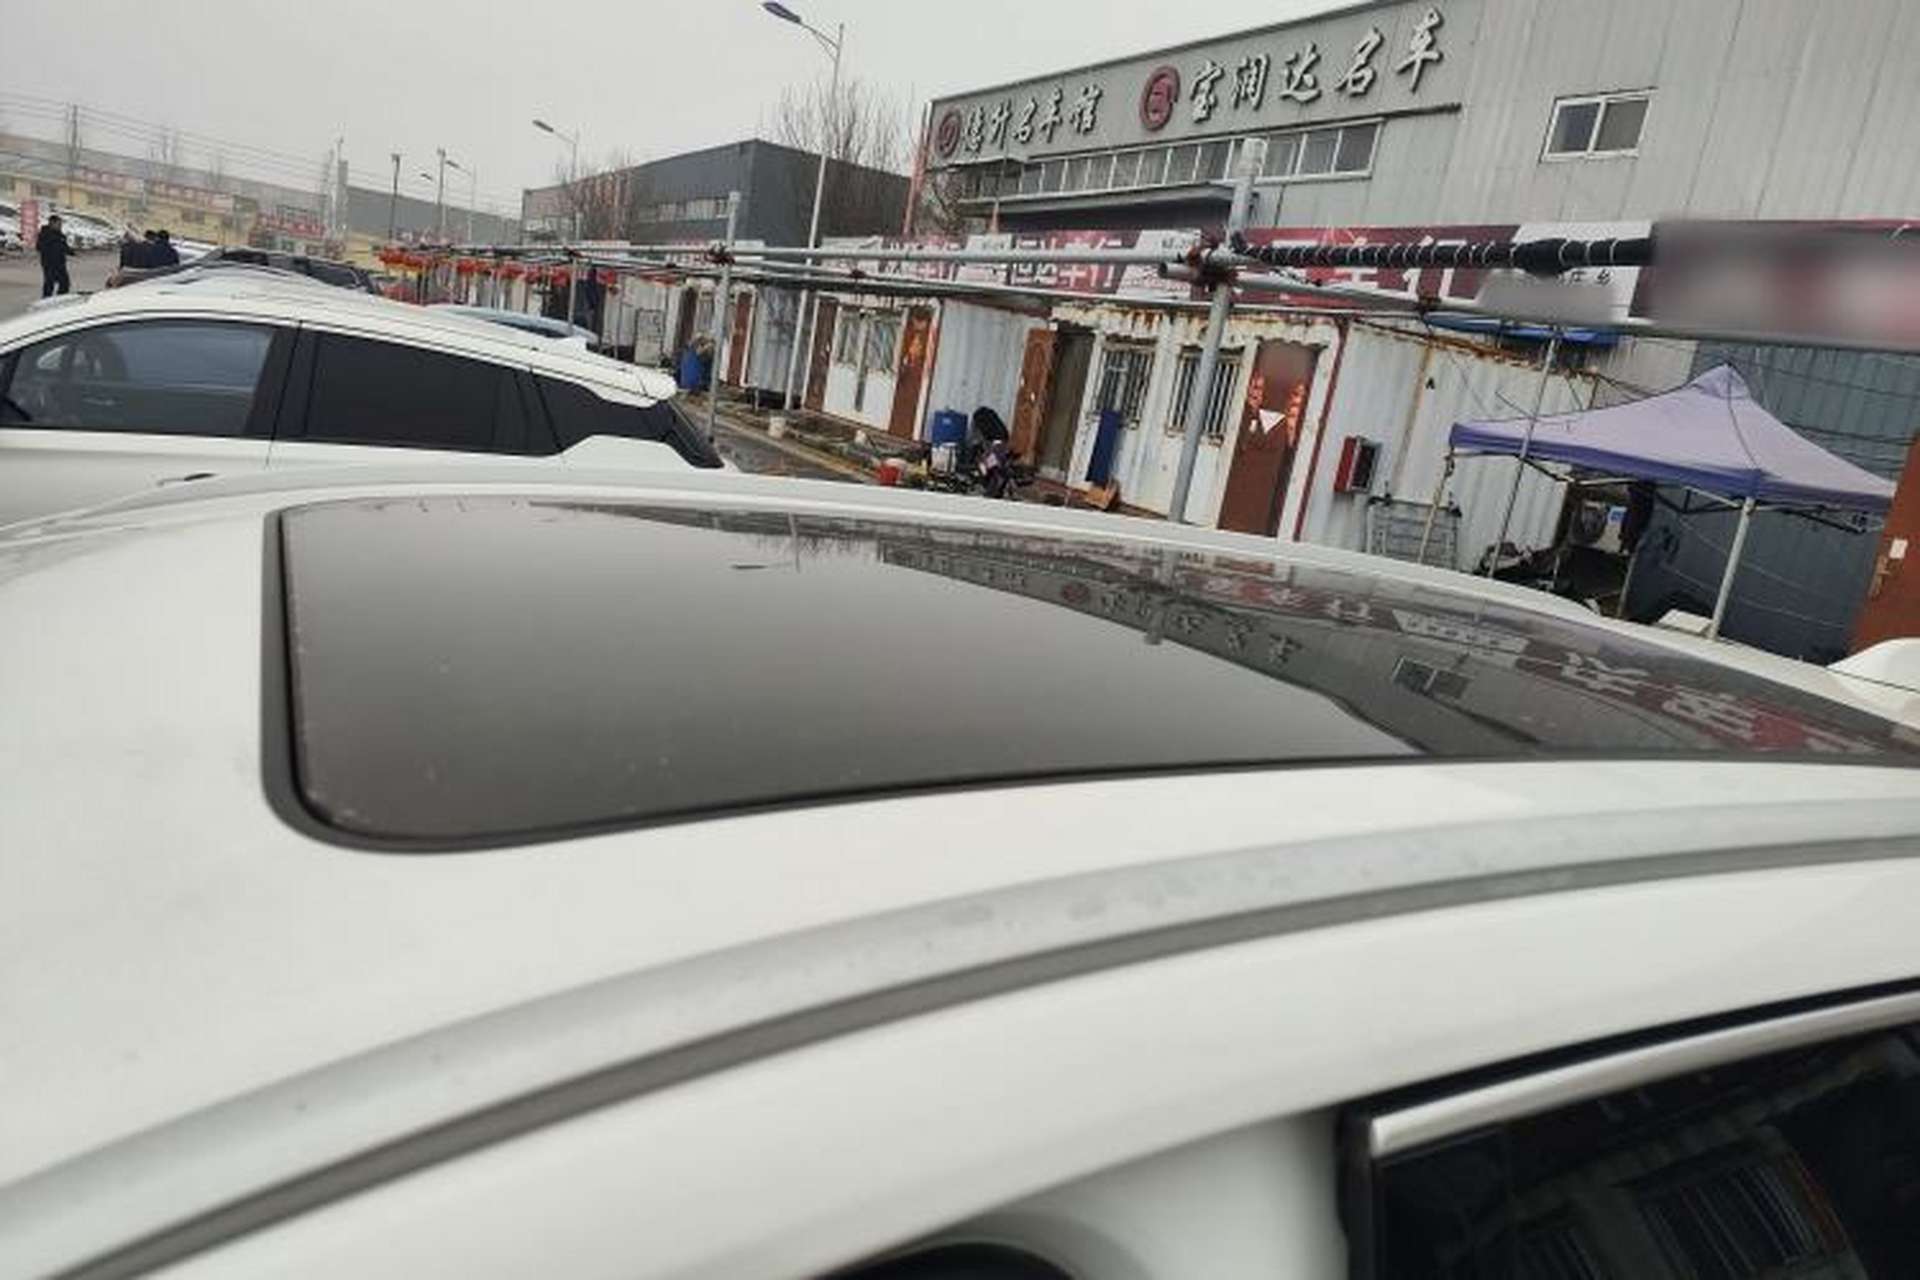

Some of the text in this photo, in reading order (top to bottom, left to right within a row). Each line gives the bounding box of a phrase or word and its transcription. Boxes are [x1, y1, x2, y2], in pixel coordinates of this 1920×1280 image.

[1190, 8, 1444, 123] 宝润达名车
